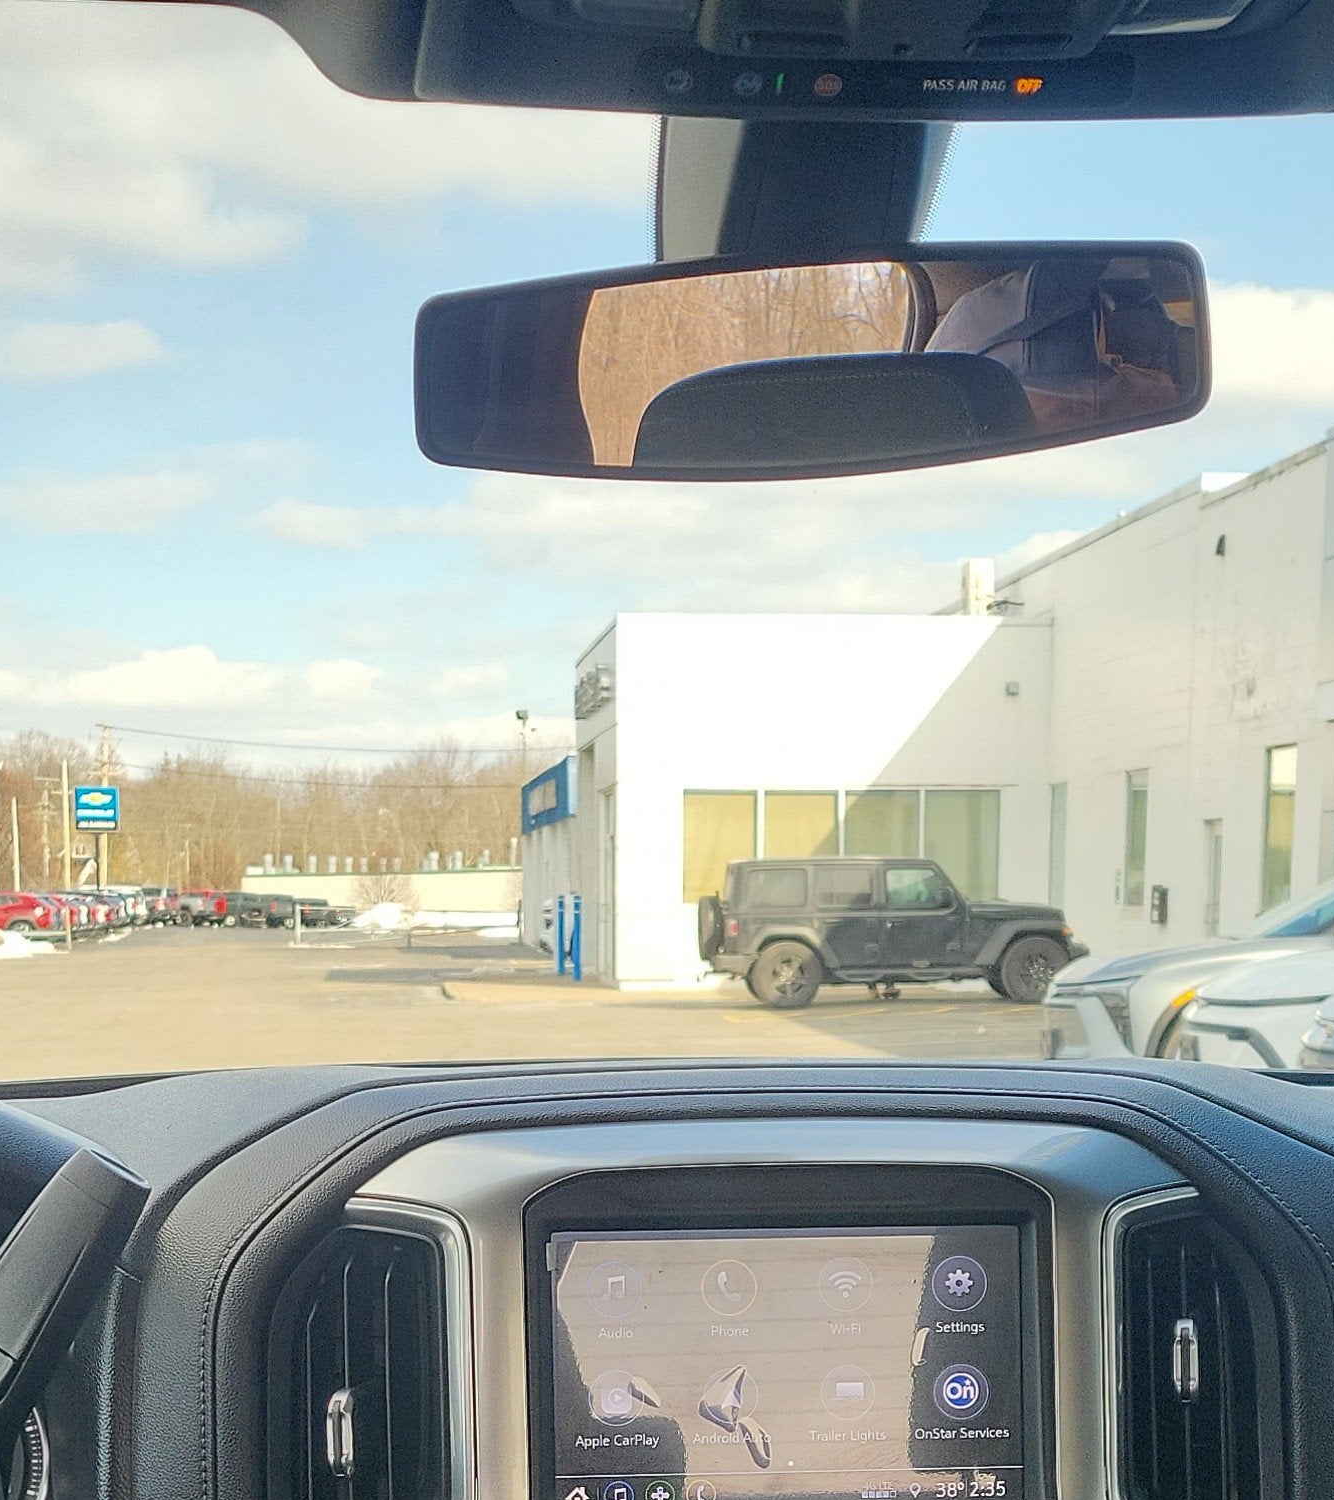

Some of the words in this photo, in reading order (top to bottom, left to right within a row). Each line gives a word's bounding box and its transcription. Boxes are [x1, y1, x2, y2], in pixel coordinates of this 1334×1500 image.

[922, 78, 954, 92] PASS
[957, 78, 979, 92] AIR
[981, 78, 1007, 92] BAG
[1016, 77, 1044, 93] OFF
[598, 1326, 635, 1340] Audio
[710, 1325, 750, 1338] Phone
[829, 1322, 862, 1335] Wi-Fi
[935, 1320, 986, 1335] Settings
[693, 1432, 740, 1445] Android
[808, 1429, 847, 1443] Trailer
[850, 1428, 887, 1444] Lights
[914, 1427, 958, 1440] OnStar
[959, 1426, 1011, 1440] Services
[574, 1434, 611, 1450] Apple
[613, 1433, 661, 1450] CarPlay
[969, 1480, 1007, 1498] 2:35
